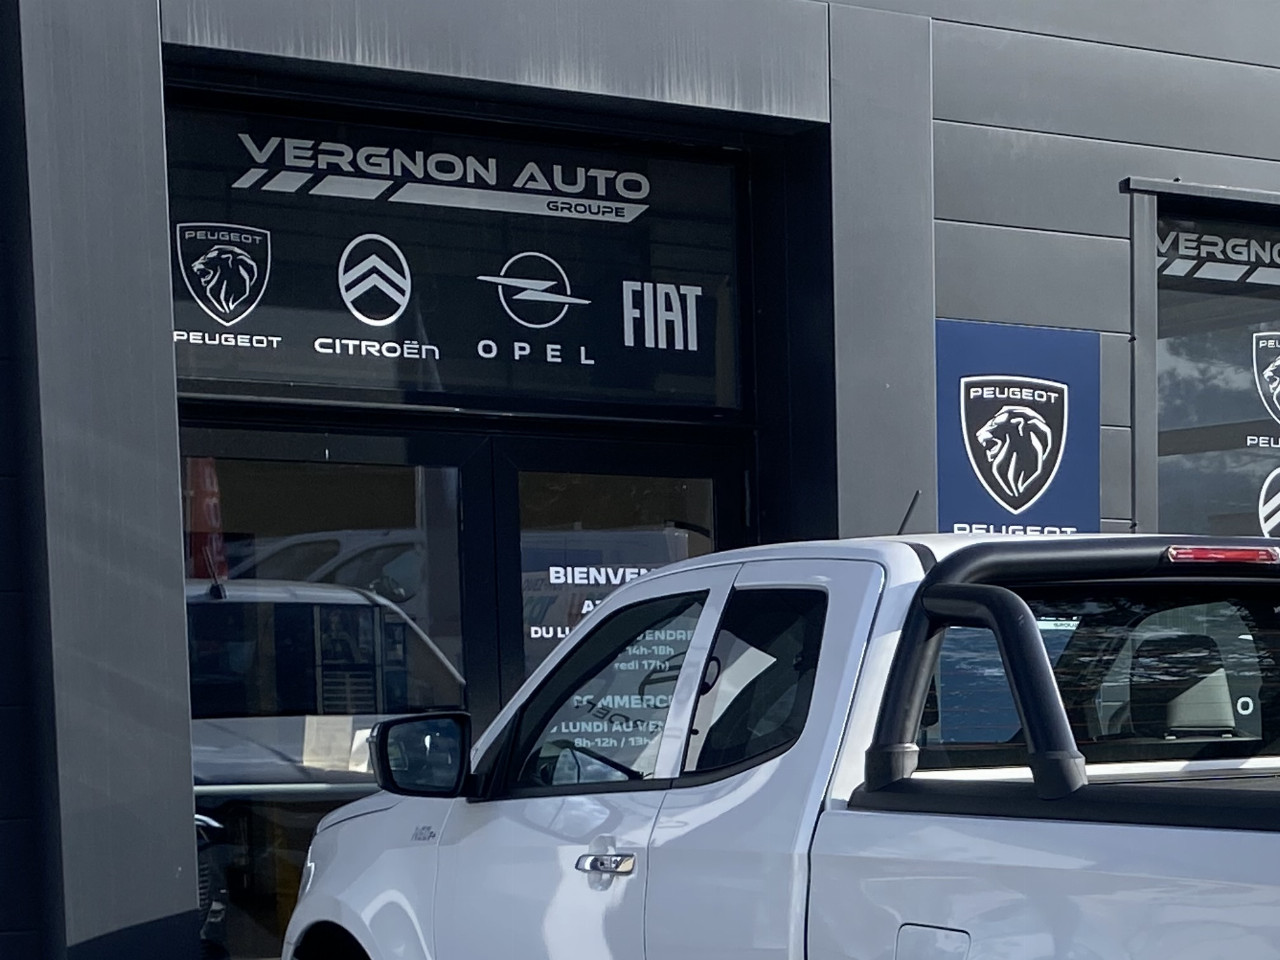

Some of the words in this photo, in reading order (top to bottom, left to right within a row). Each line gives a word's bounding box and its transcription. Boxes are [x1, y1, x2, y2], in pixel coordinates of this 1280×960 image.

[238, 133, 497, 184] VERGNON
[513, 161, 650, 199] AUTO
[546, 200, 626, 218] GROUPE
[185, 230, 263, 244] PEUGEOT
[622, 280, 702, 351] FIAT
[173, 331, 282, 348] PEUGEOT
[477, 339, 595, 365] OPEL
[968, 386, 1059, 403] PEUGEOT
[530, 626, 554, 638] DU
[561, 721, 608, 733] LUNDI
